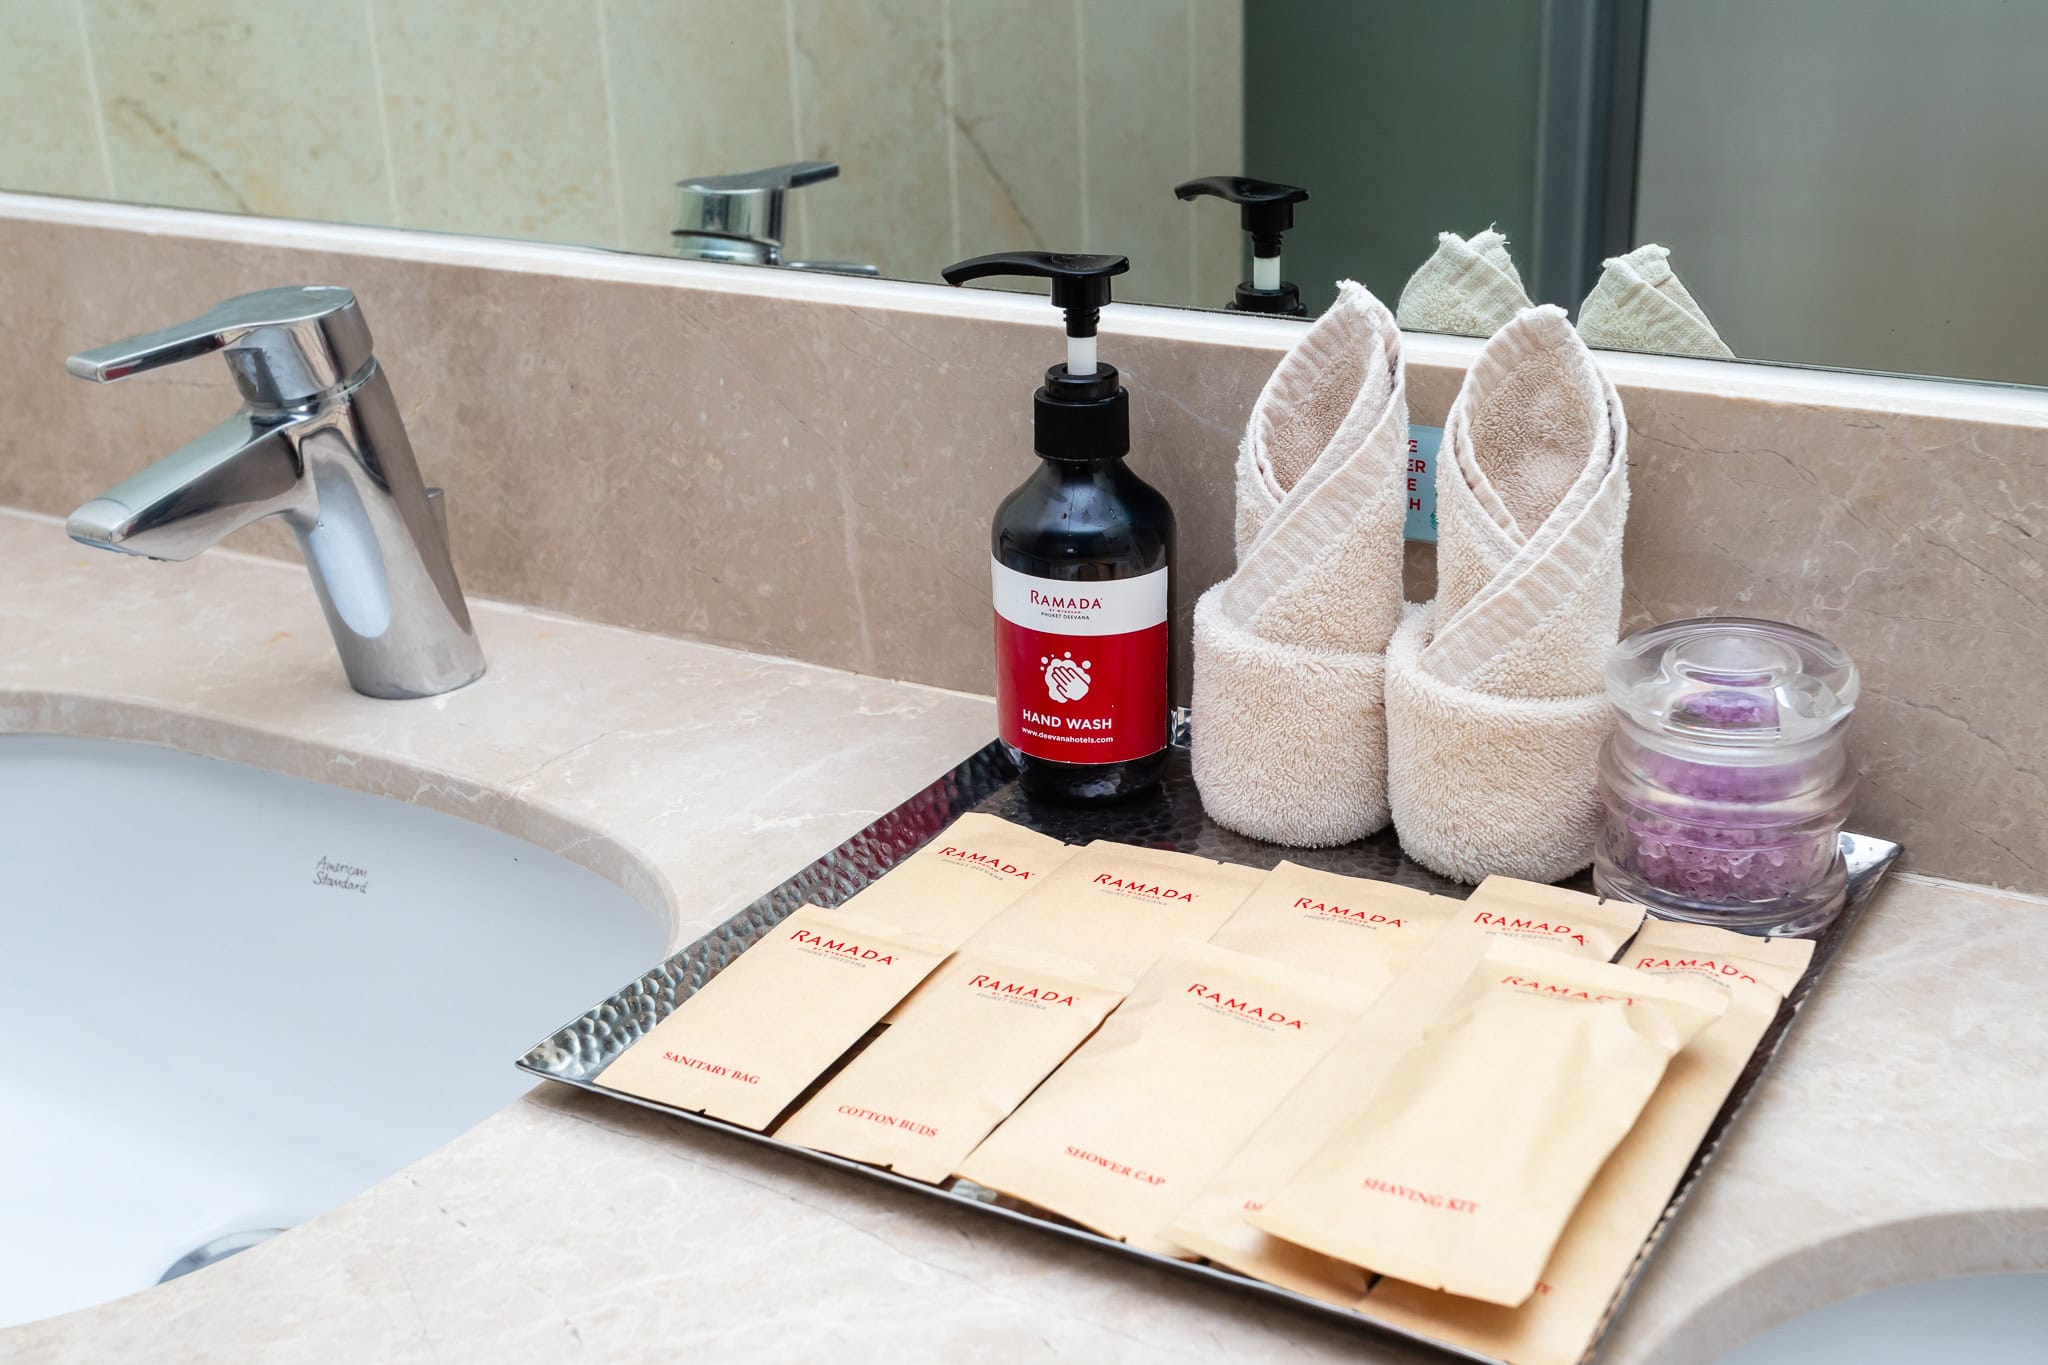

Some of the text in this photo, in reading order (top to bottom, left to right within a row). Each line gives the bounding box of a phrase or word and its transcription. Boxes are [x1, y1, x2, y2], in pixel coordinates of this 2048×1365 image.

[1030, 589, 1102, 609] RAMADA
[1023, 708, 1112, 730] HAND WASH
[1021, 727, 1114, 743] www.deevanahotels.com
[316, 855, 367, 877] American
[938, 846, 1032, 880] RAMADA
[313, 871, 368, 894] Standard
[1093, 873, 1195, 902] RAMADA
[1293, 897, 1403, 928] RAMADA
[1474, 912, 1586, 946] RAMADA
[790, 929, 895, 965] RAMADA
[968, 974, 1076, 1006] RAMADA
[1187, 983, 1303, 1029] RAMADA
[663, 1051, 760, 1084] SANITARY BAG
[838, 1104, 938, 1136] COTTON BUDS
[1065, 1145, 1131, 1176] SHOWER
[1361, 1177, 1481, 1215] SHAVING KIT
